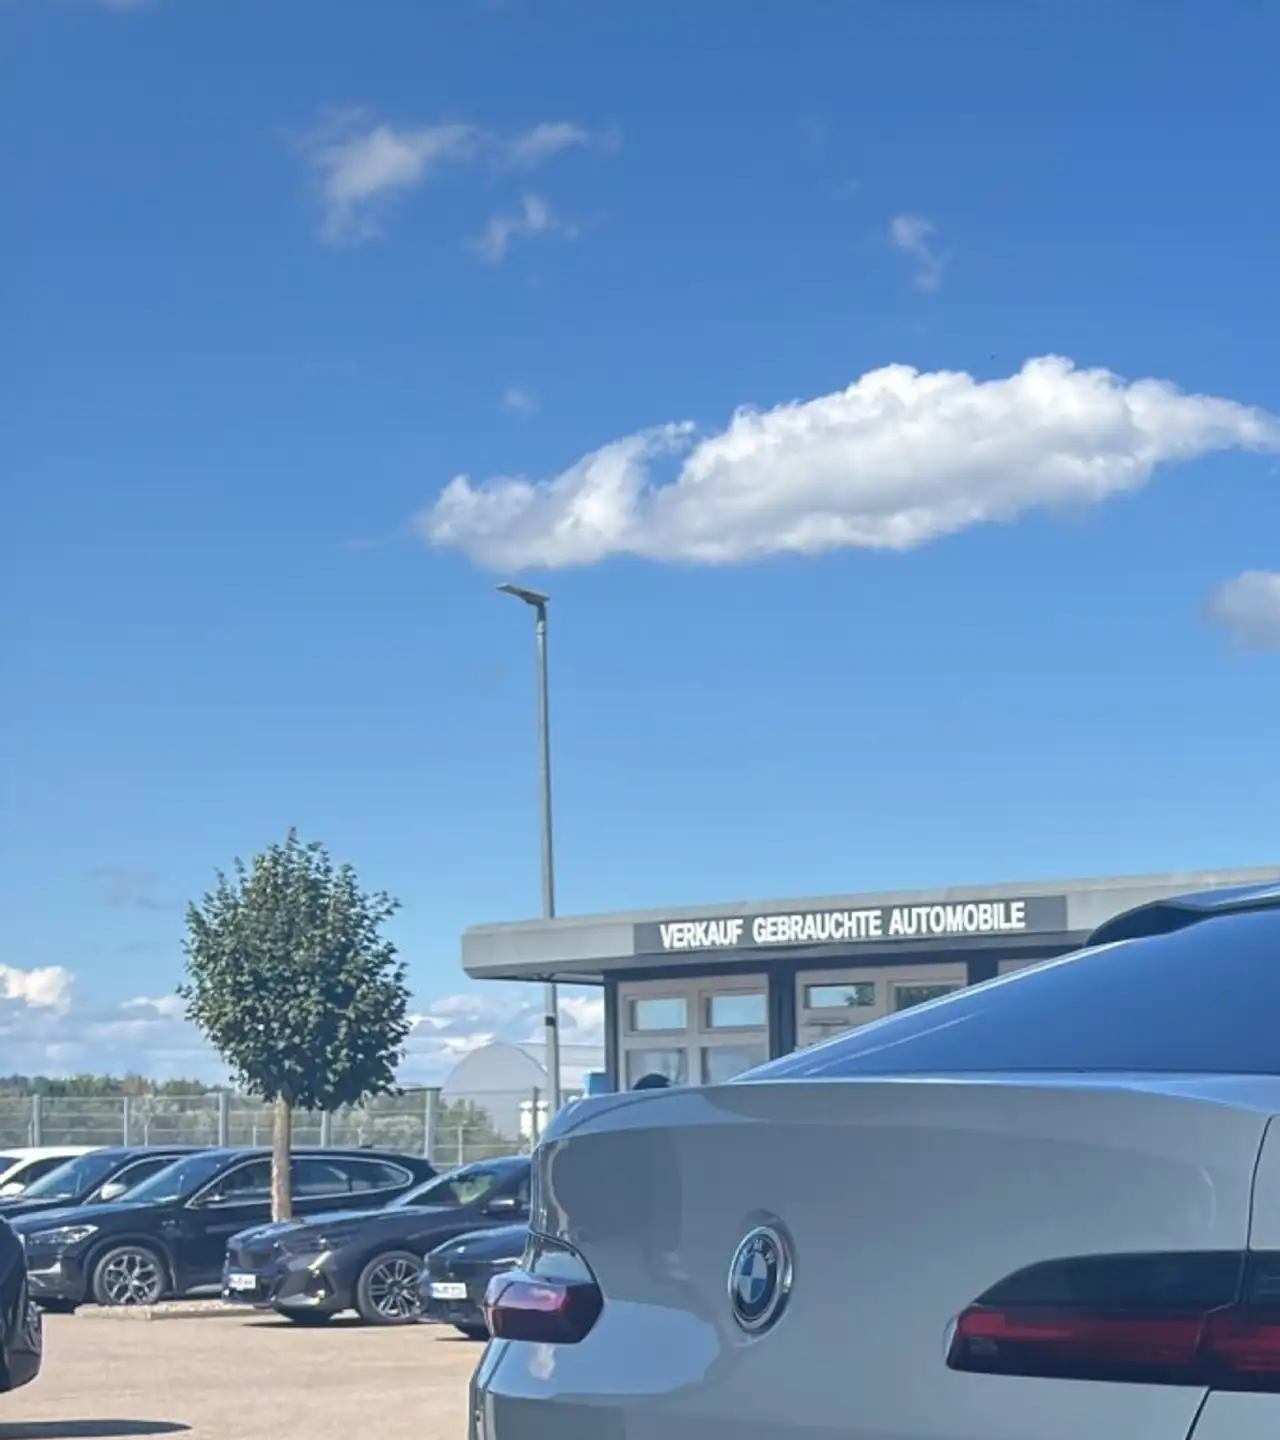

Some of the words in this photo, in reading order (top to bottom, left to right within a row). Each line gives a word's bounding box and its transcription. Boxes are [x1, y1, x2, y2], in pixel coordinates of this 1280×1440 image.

[659, 919, 744, 950] VERKAUF
[752, 909, 883, 944] GEBRAUCHTE
[888, 901, 1026, 937] AUTOMOBILE
